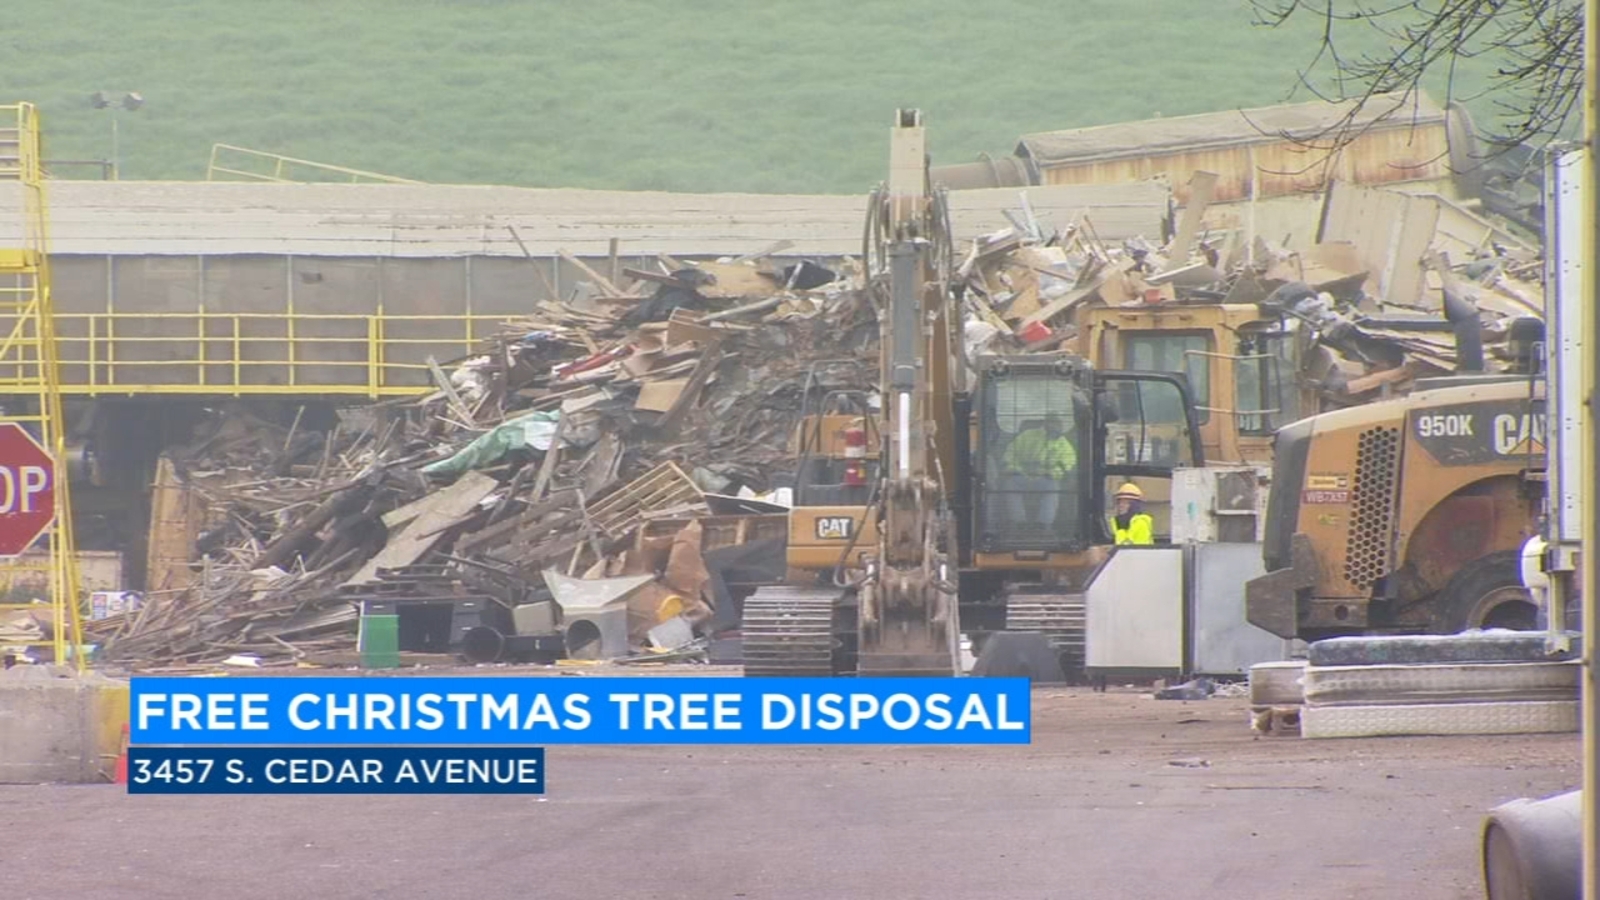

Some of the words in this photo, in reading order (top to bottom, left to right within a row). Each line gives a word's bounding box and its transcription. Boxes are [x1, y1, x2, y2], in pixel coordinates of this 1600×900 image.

[1419, 414, 1473, 437] 950K
[1494, 413, 1546, 455] CA
[818, 518, 850, 538] CAT
